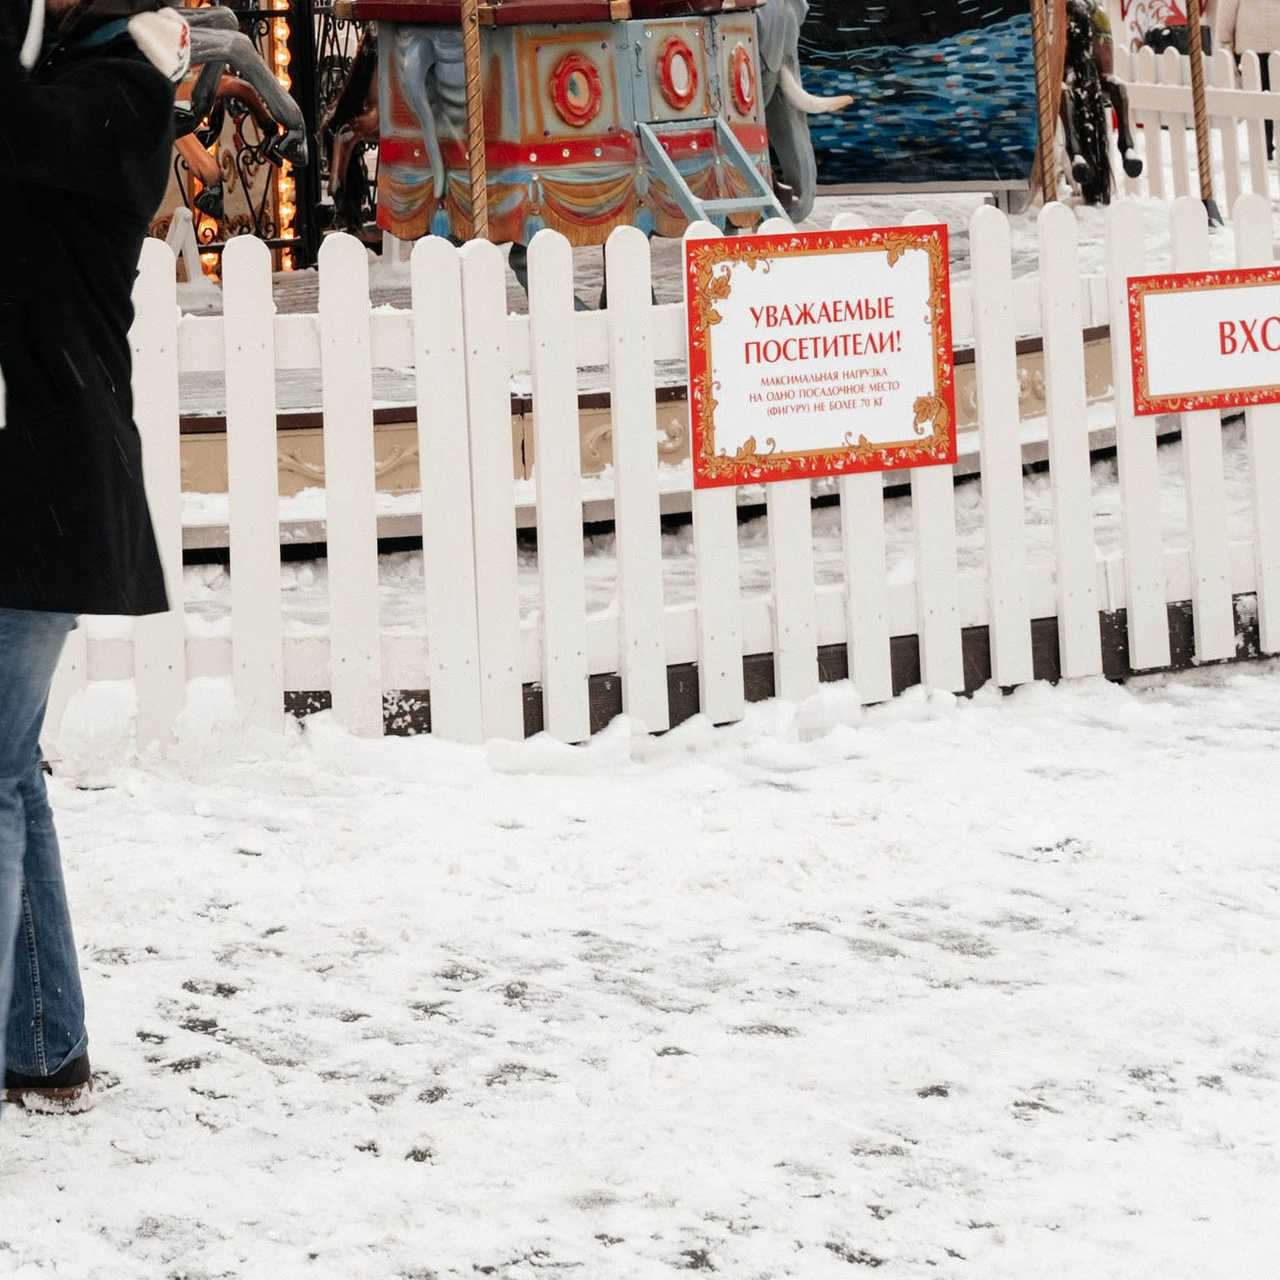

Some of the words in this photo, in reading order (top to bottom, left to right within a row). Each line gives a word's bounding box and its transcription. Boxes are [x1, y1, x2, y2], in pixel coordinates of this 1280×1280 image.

[749, 296, 894, 329] УВАЖАЕМЫЕ
[745, 330, 901, 364] ПОСЕТИТЕЛИ!
[1219, 316, 1280, 355] ВХО
[760, 371, 839, 387] МАКСИМАЛЬНАЯ
[842, 367, 888, 380] НАГРУЗКА
[749, 393, 763, 403] НА
[766, 390, 796, 402] ОДНО
[799, 384, 865, 398] ПОСАДОЧНОЕ
[869, 381, 900, 391] МЕСТО
[767, 403, 810, 416] (ФИГУРУ)
[813, 402, 825, 412] НЕ
[830, 399, 857, 410] БОЛЕЕ
[861, 398, 870, 408] 70
[874, 397, 884, 406] КГ
